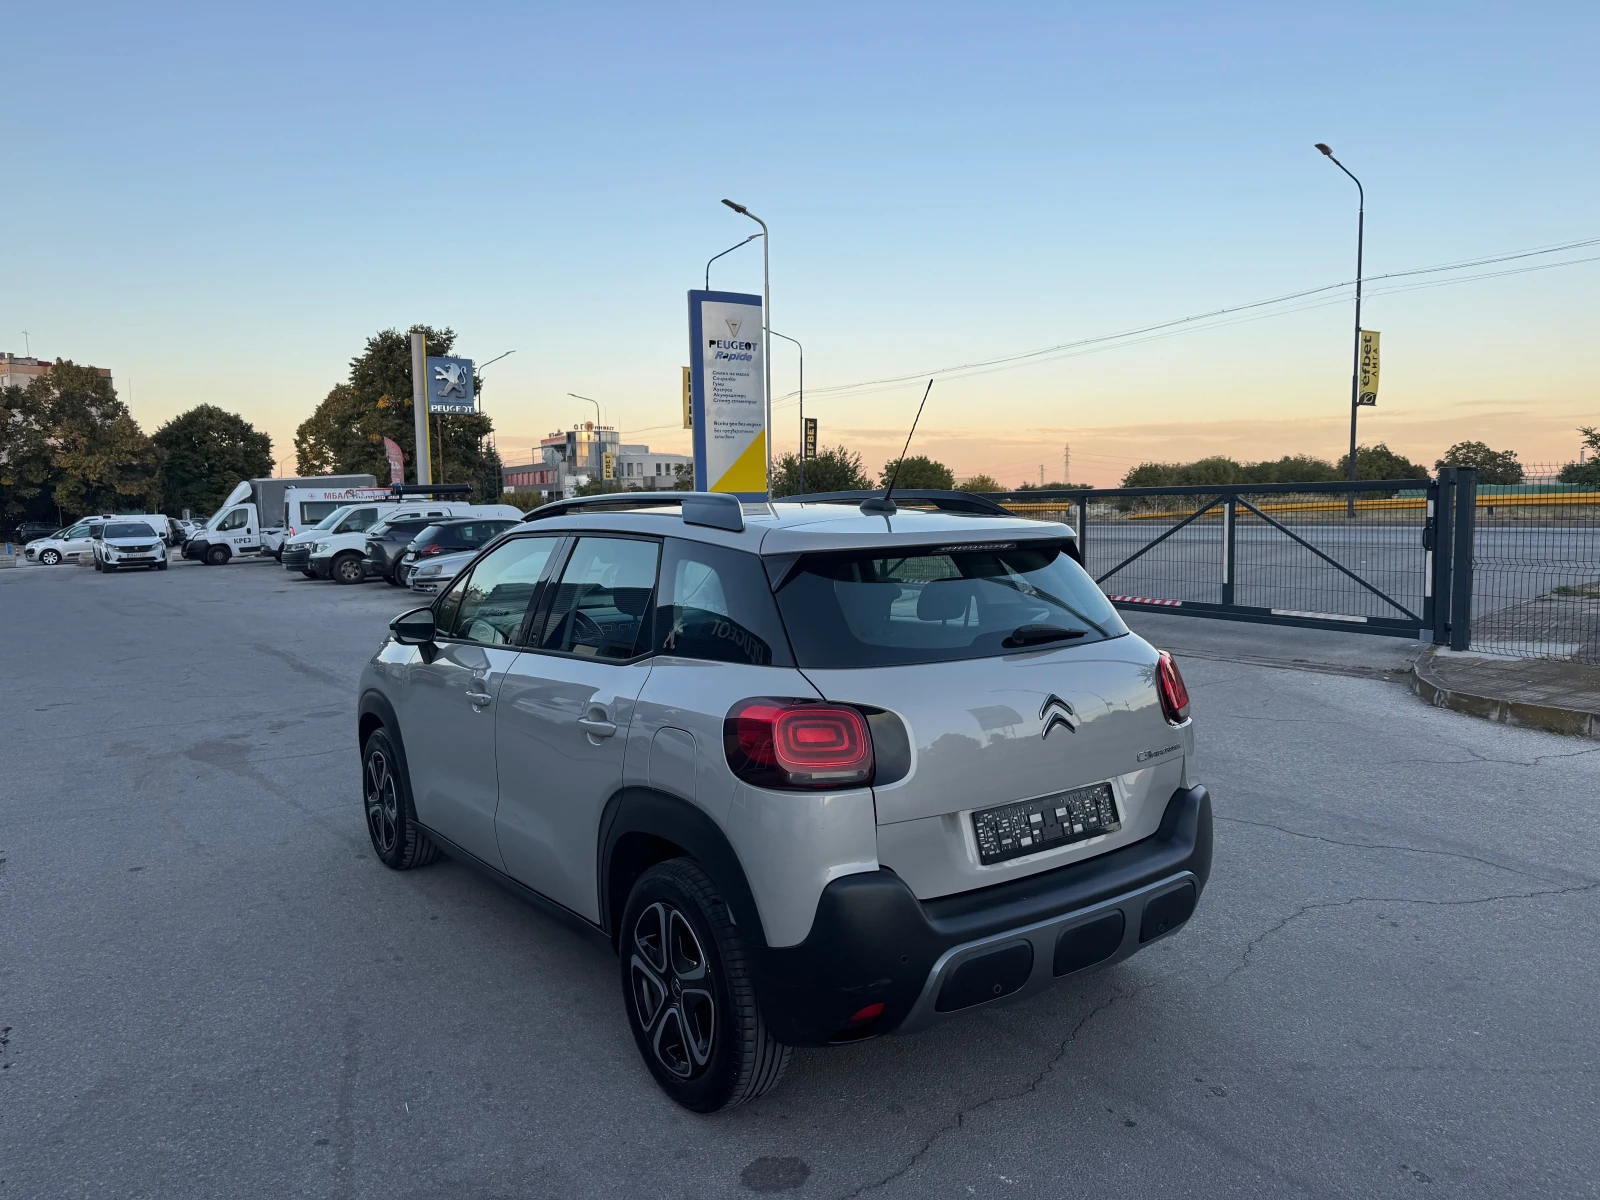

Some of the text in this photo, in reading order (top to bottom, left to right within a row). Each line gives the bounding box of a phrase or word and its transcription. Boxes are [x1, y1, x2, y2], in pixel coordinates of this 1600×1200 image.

[708, 339, 758, 351] PEUGEOT
[715, 350, 753, 361] Rapide
[1362, 336, 1372, 387] efbet
[431, 404, 473, 413] PEUGEOT
[807, 420, 815, 456] EFBET
